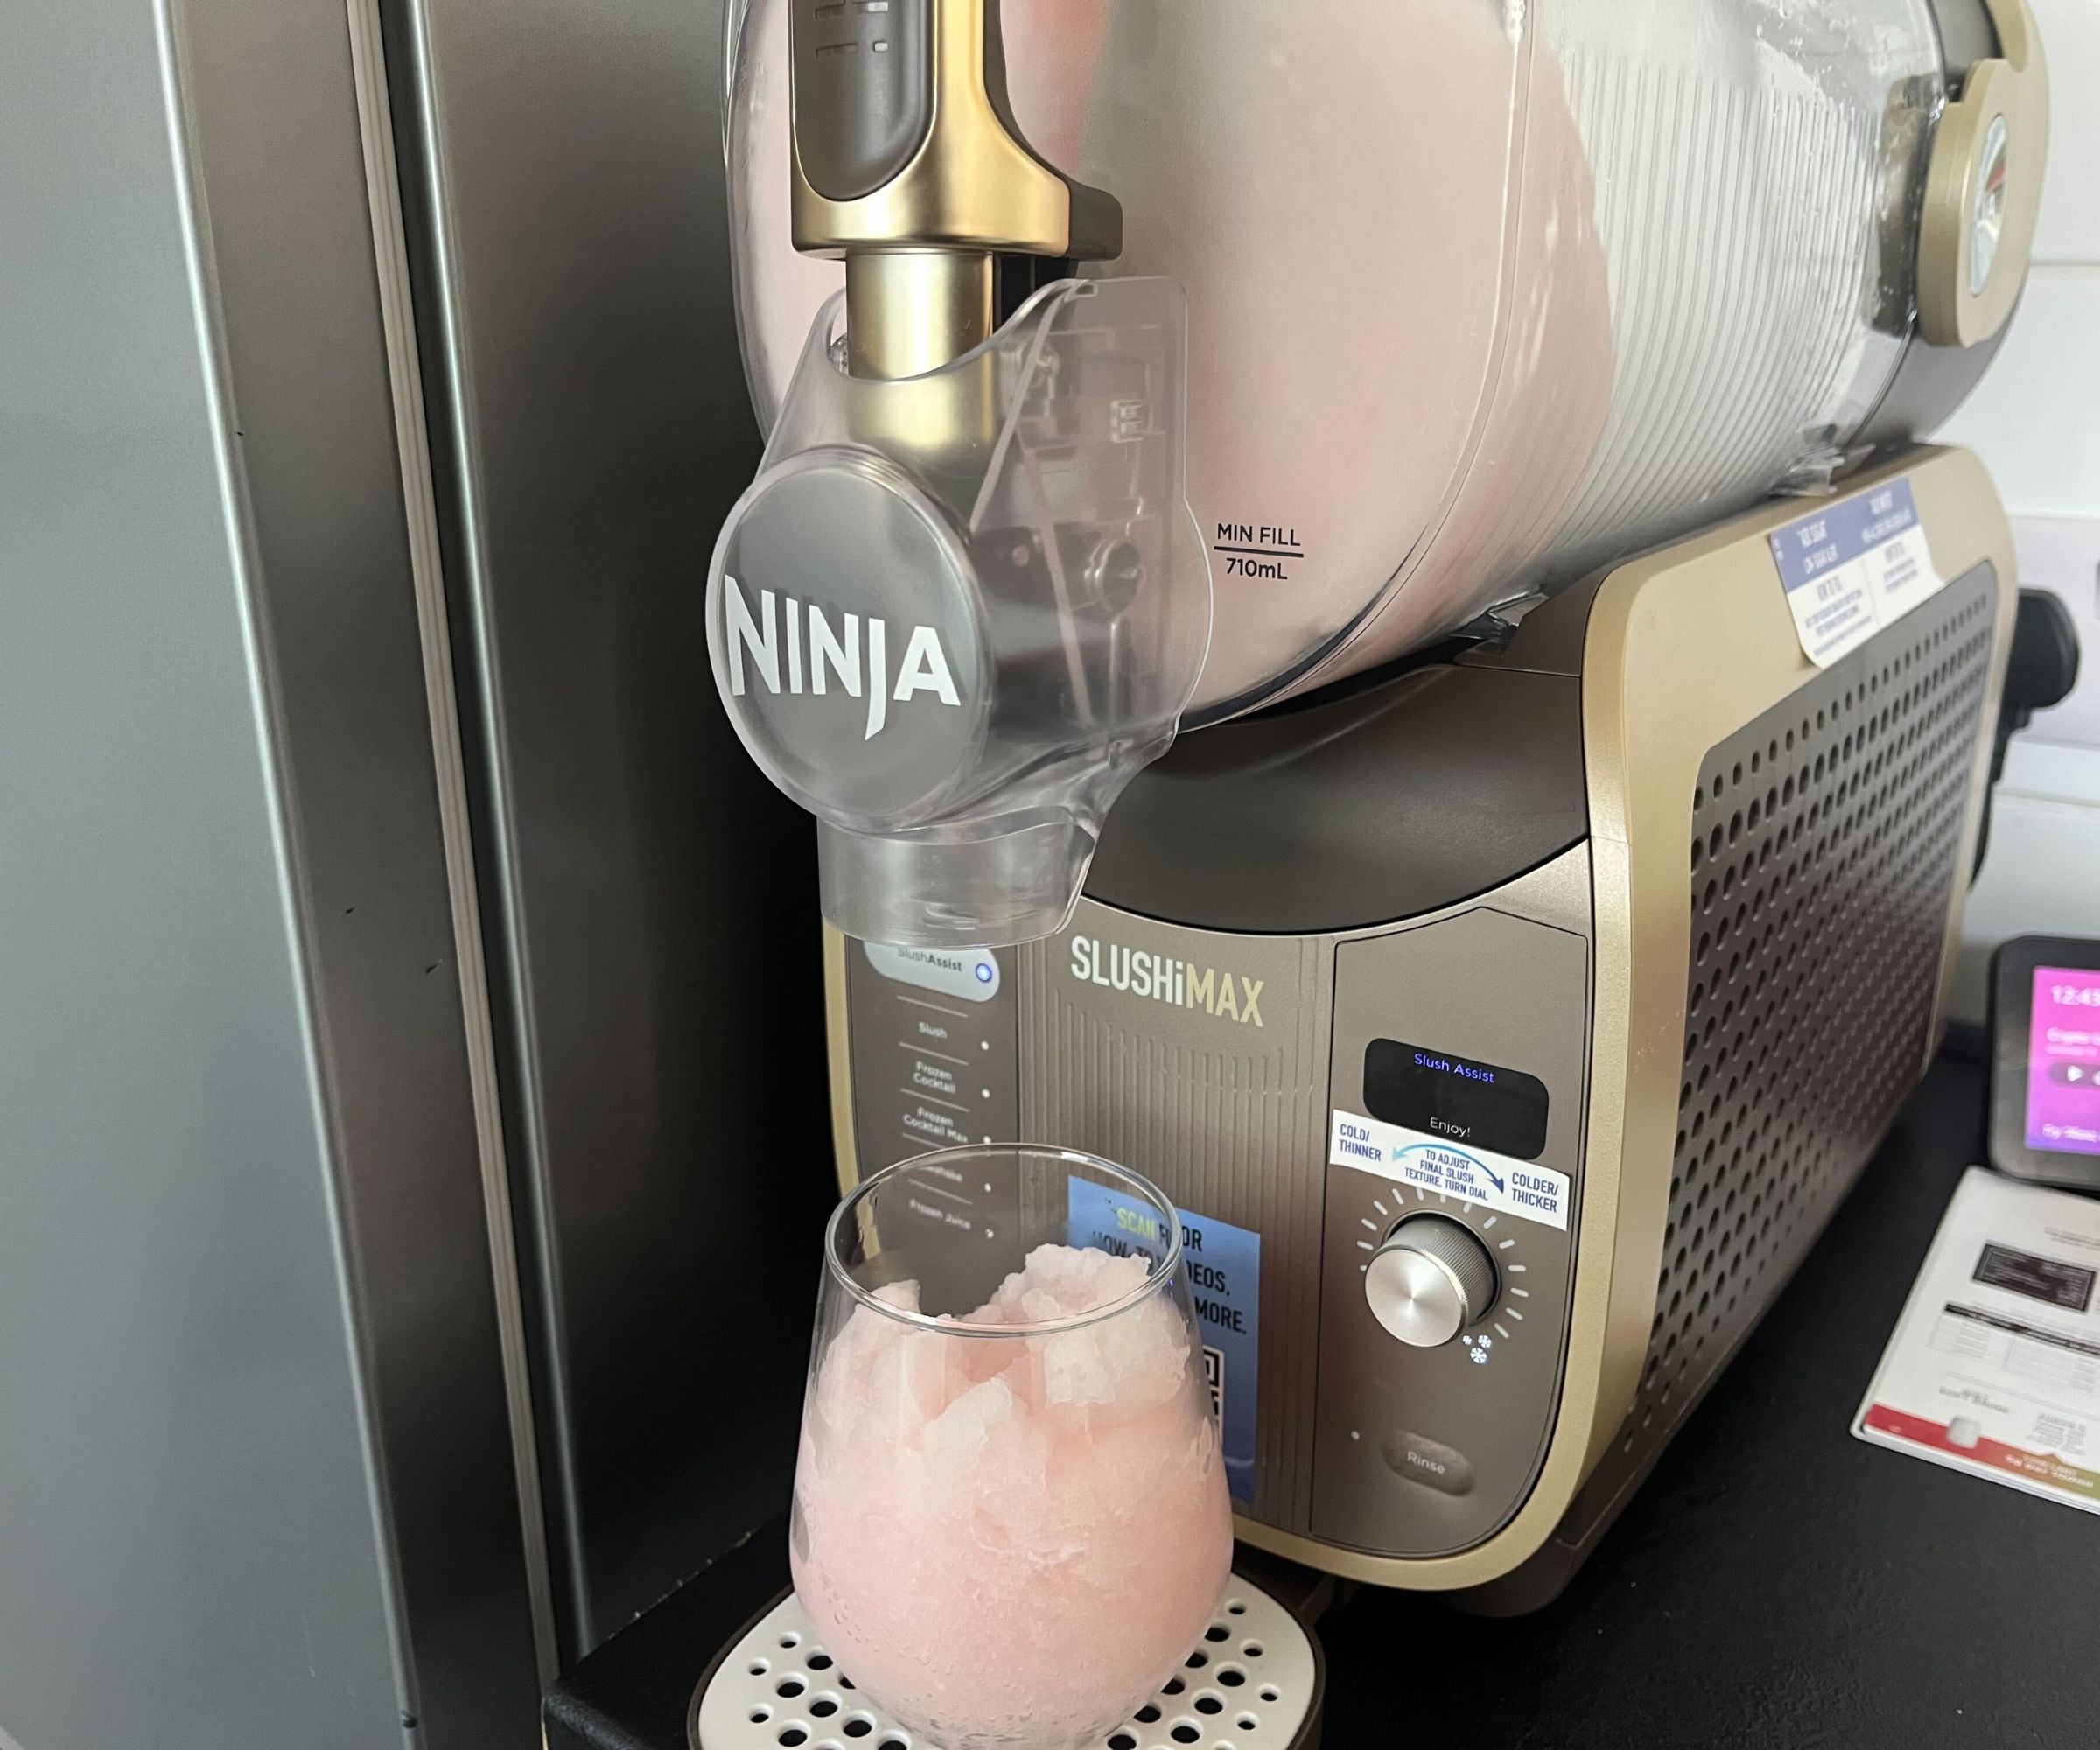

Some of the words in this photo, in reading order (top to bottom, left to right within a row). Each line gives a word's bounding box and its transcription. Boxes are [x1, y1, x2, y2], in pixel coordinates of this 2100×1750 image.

[1217, 523, 1253, 542] MIN
[1259, 527, 1301, 547] FILL
[1226, 557, 1288, 580] 710mL
[724, 574, 962, 741] NINJA
[1070, 935, 1264, 1028] SLUSHiMAX
[918, 1021, 948, 1039] Slush
[915, 1060, 953, 1081] Frozen
[1414, 1053, 1450, 1073] Slush
[1454, 1063, 1495, 1083] Assist
[913, 1072, 956, 1094] Cocktail
[902, 1114, 946, 1137] Cocktail
[916, 1106, 954, 1127] Frozen
[1429, 1116, 1471, 1138] Enjoy!
[1340, 1124, 1370, 1142] COLD/
[1339, 1139, 1382, 1162] THINNER
[1425, 1149, 1436, 1161] TO
[1438, 1152, 1470, 1171] ADJUST
[1419, 1159, 1445, 1176] FINAL
[1446, 1167, 1474, 1184] SLUSH
[1445, 1178, 1466, 1194] TURN
[1468, 1185, 1488, 1201] DIAL
[1512, 1172, 1559, 1195] COLDER/
[1511, 1187, 1558, 1213] THICKER
[1116, 1207, 1156, 1242] SCAN
[1194, 1296, 1248, 1335] MORE.
[1407, 1451, 1446, 1475] Rinse
